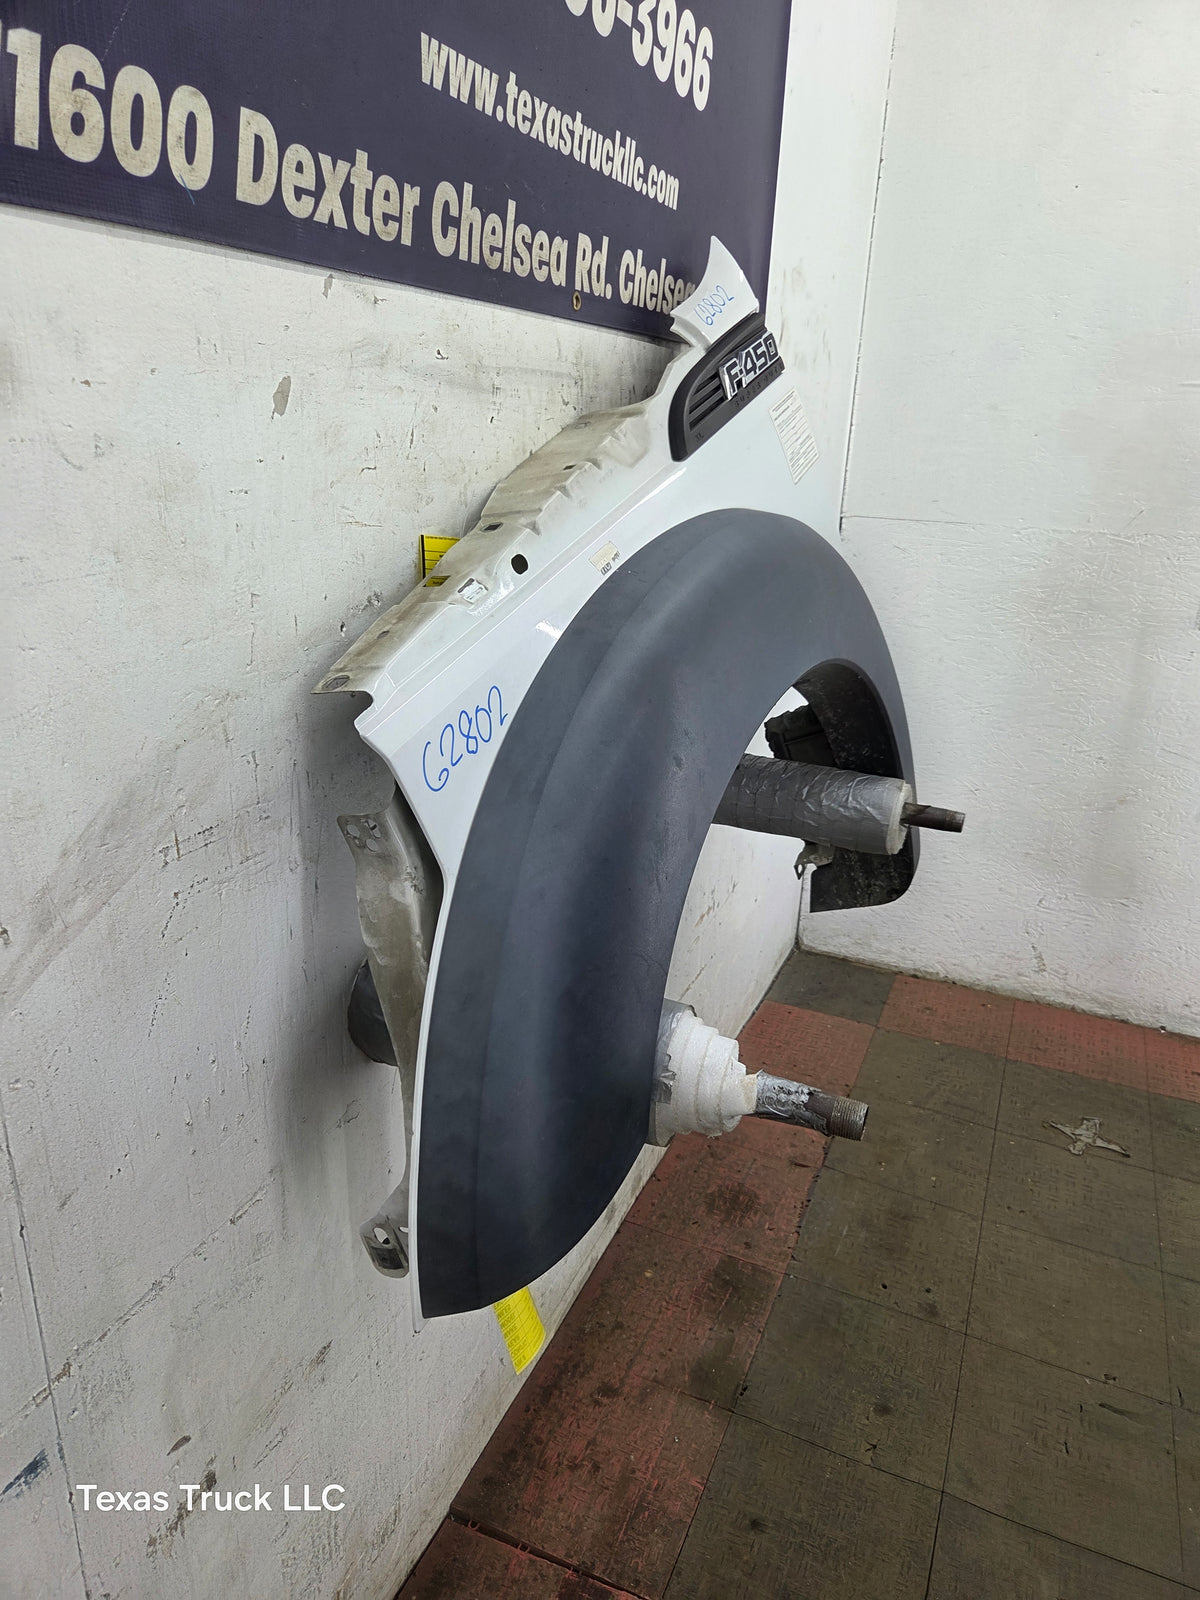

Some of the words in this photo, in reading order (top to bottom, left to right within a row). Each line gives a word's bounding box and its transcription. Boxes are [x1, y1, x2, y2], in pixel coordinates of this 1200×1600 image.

[564, 0, 714, 112] -3966
[420, 31, 680, 211] www.texastruckllc.com
[235, 106, 421, 247] Dexter
[431, 180, 569, 287] Chelsea
[574, 232, 613, 300] Rd.
[694, 284, 735, 326] 62802
[721, 331, 780, 400] F-450
